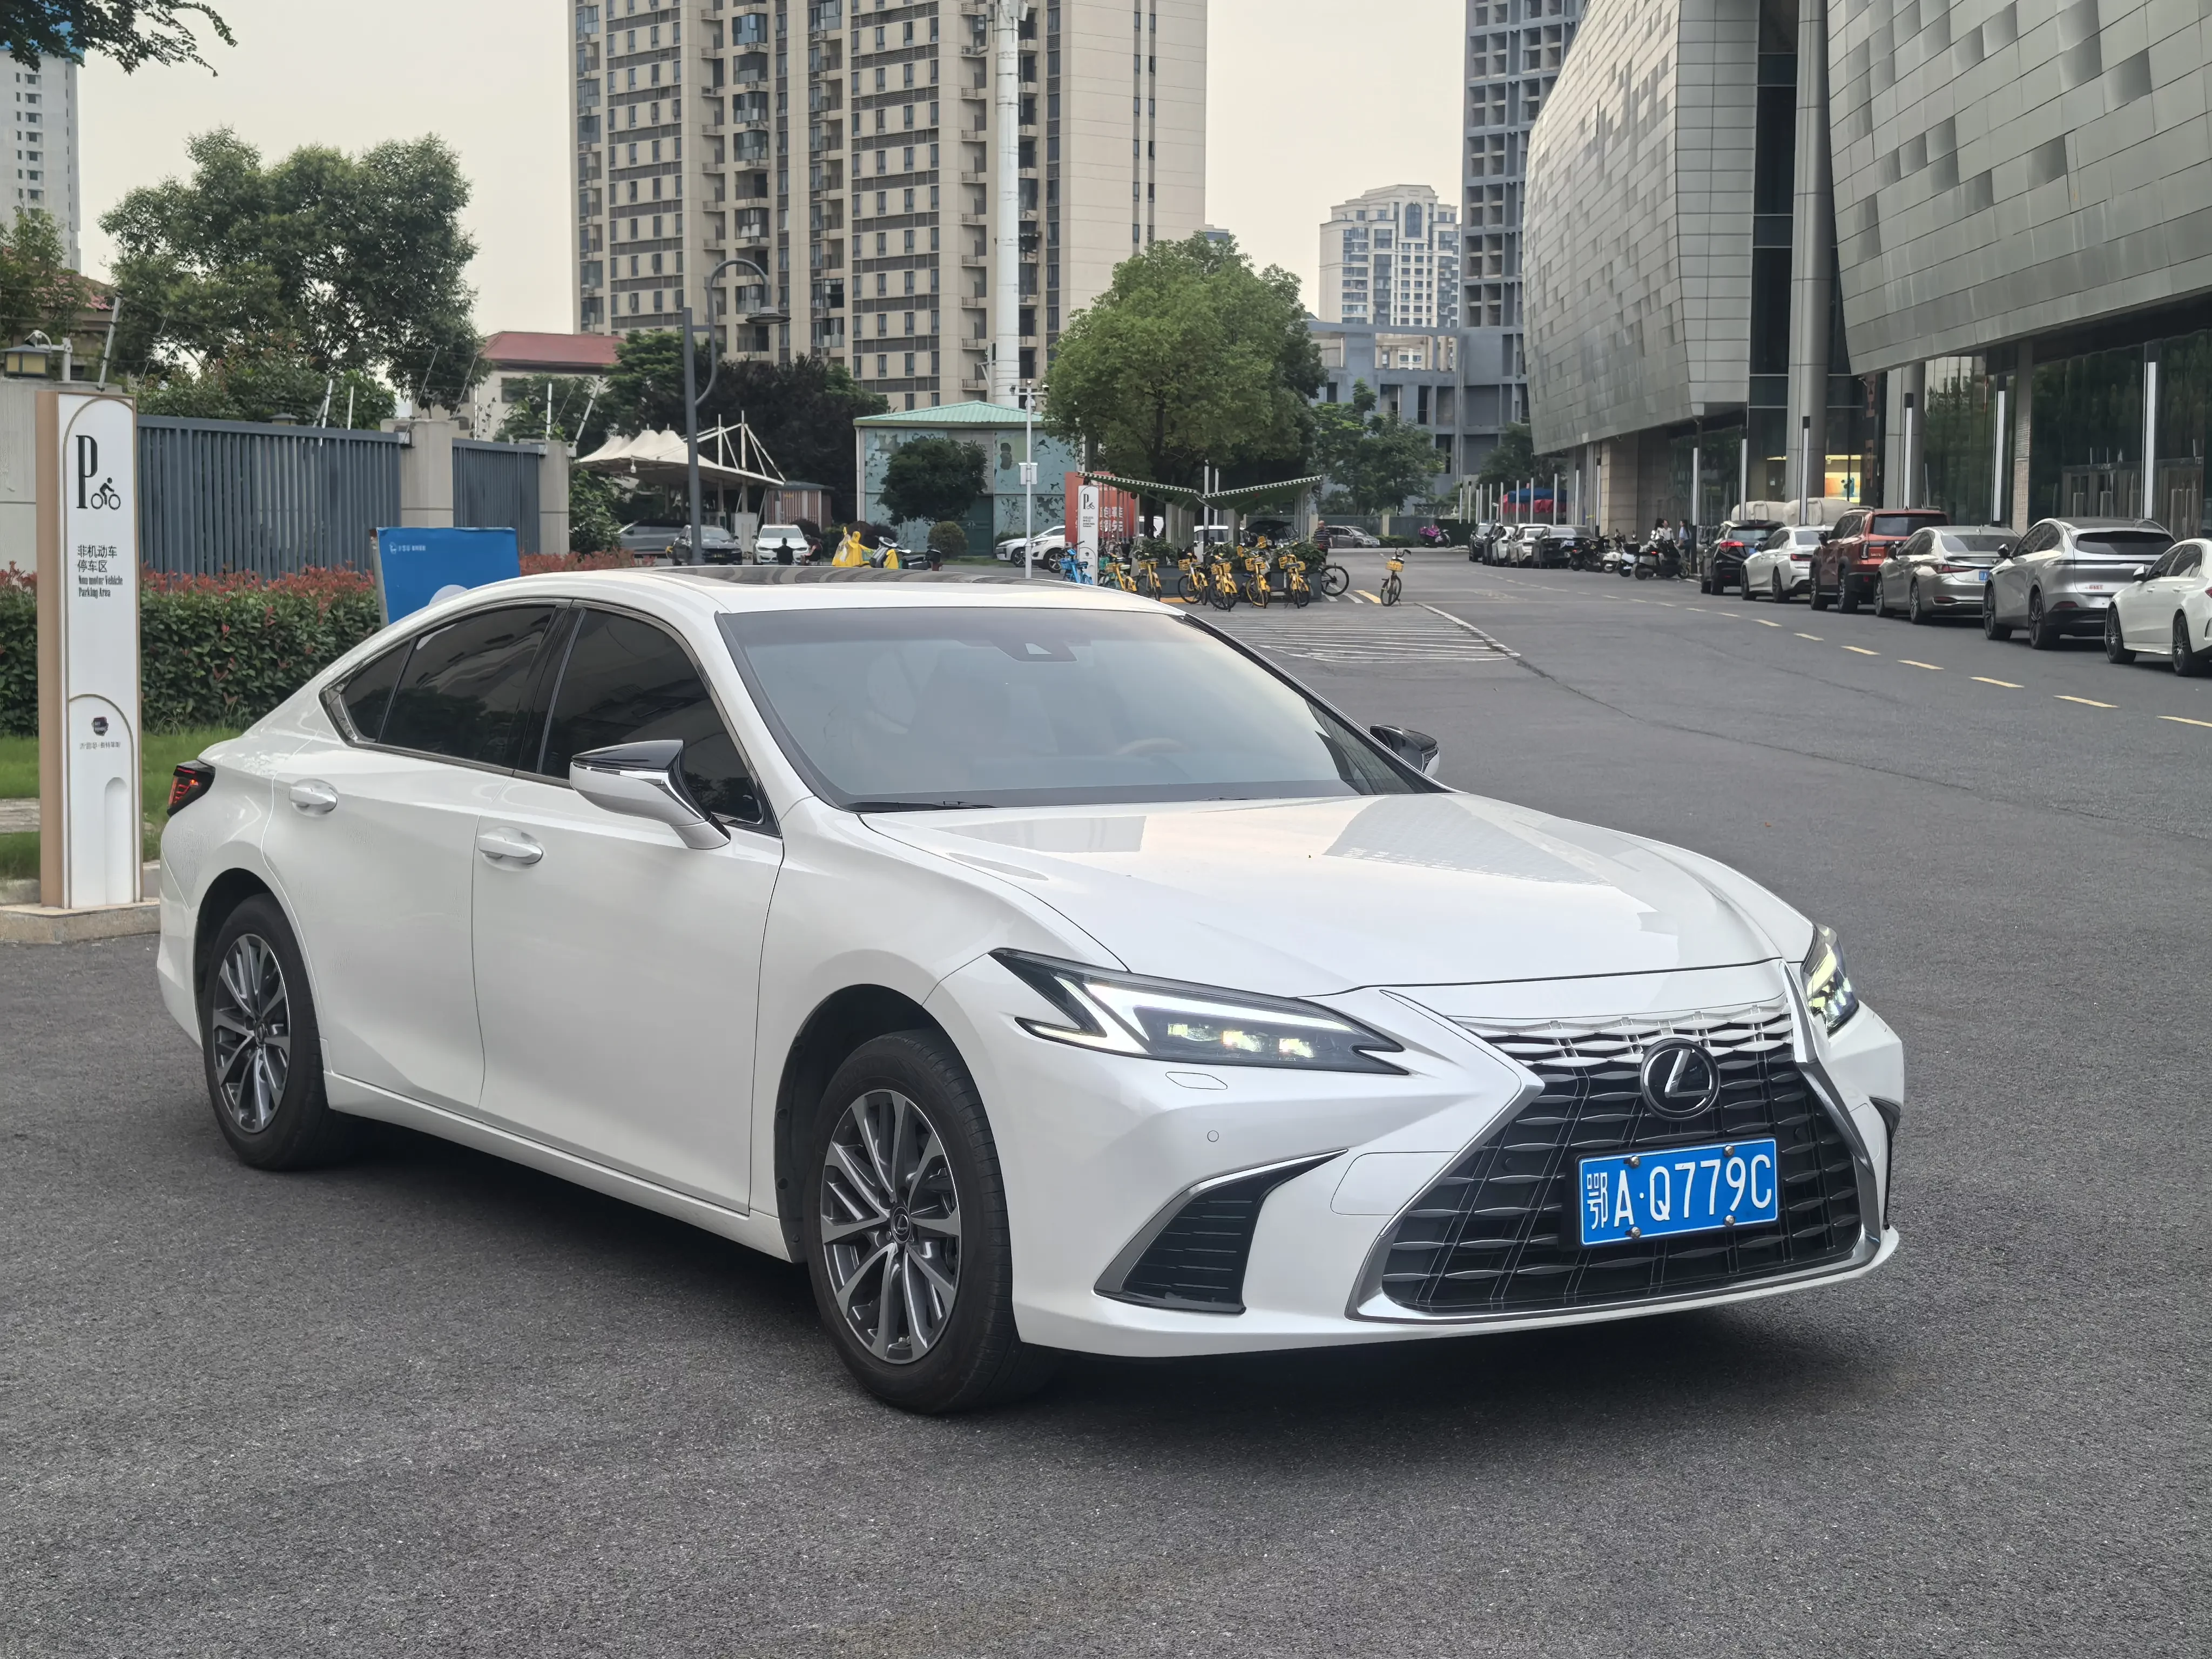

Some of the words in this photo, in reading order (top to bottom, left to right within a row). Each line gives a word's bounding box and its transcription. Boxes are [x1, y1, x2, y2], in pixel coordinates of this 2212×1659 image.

[76, 435, 98, 509] P
[1083, 493, 1089, 509] P
[77, 544, 117, 558] 非机动车
[77, 559, 107, 572] 停车区
[105, 575, 123, 585] Vehicle
[78, 586, 98, 599] Parking
[99, 586, 111, 597] Area
[1586, 1154, 1772, 1230] 鄂A·Q779C
